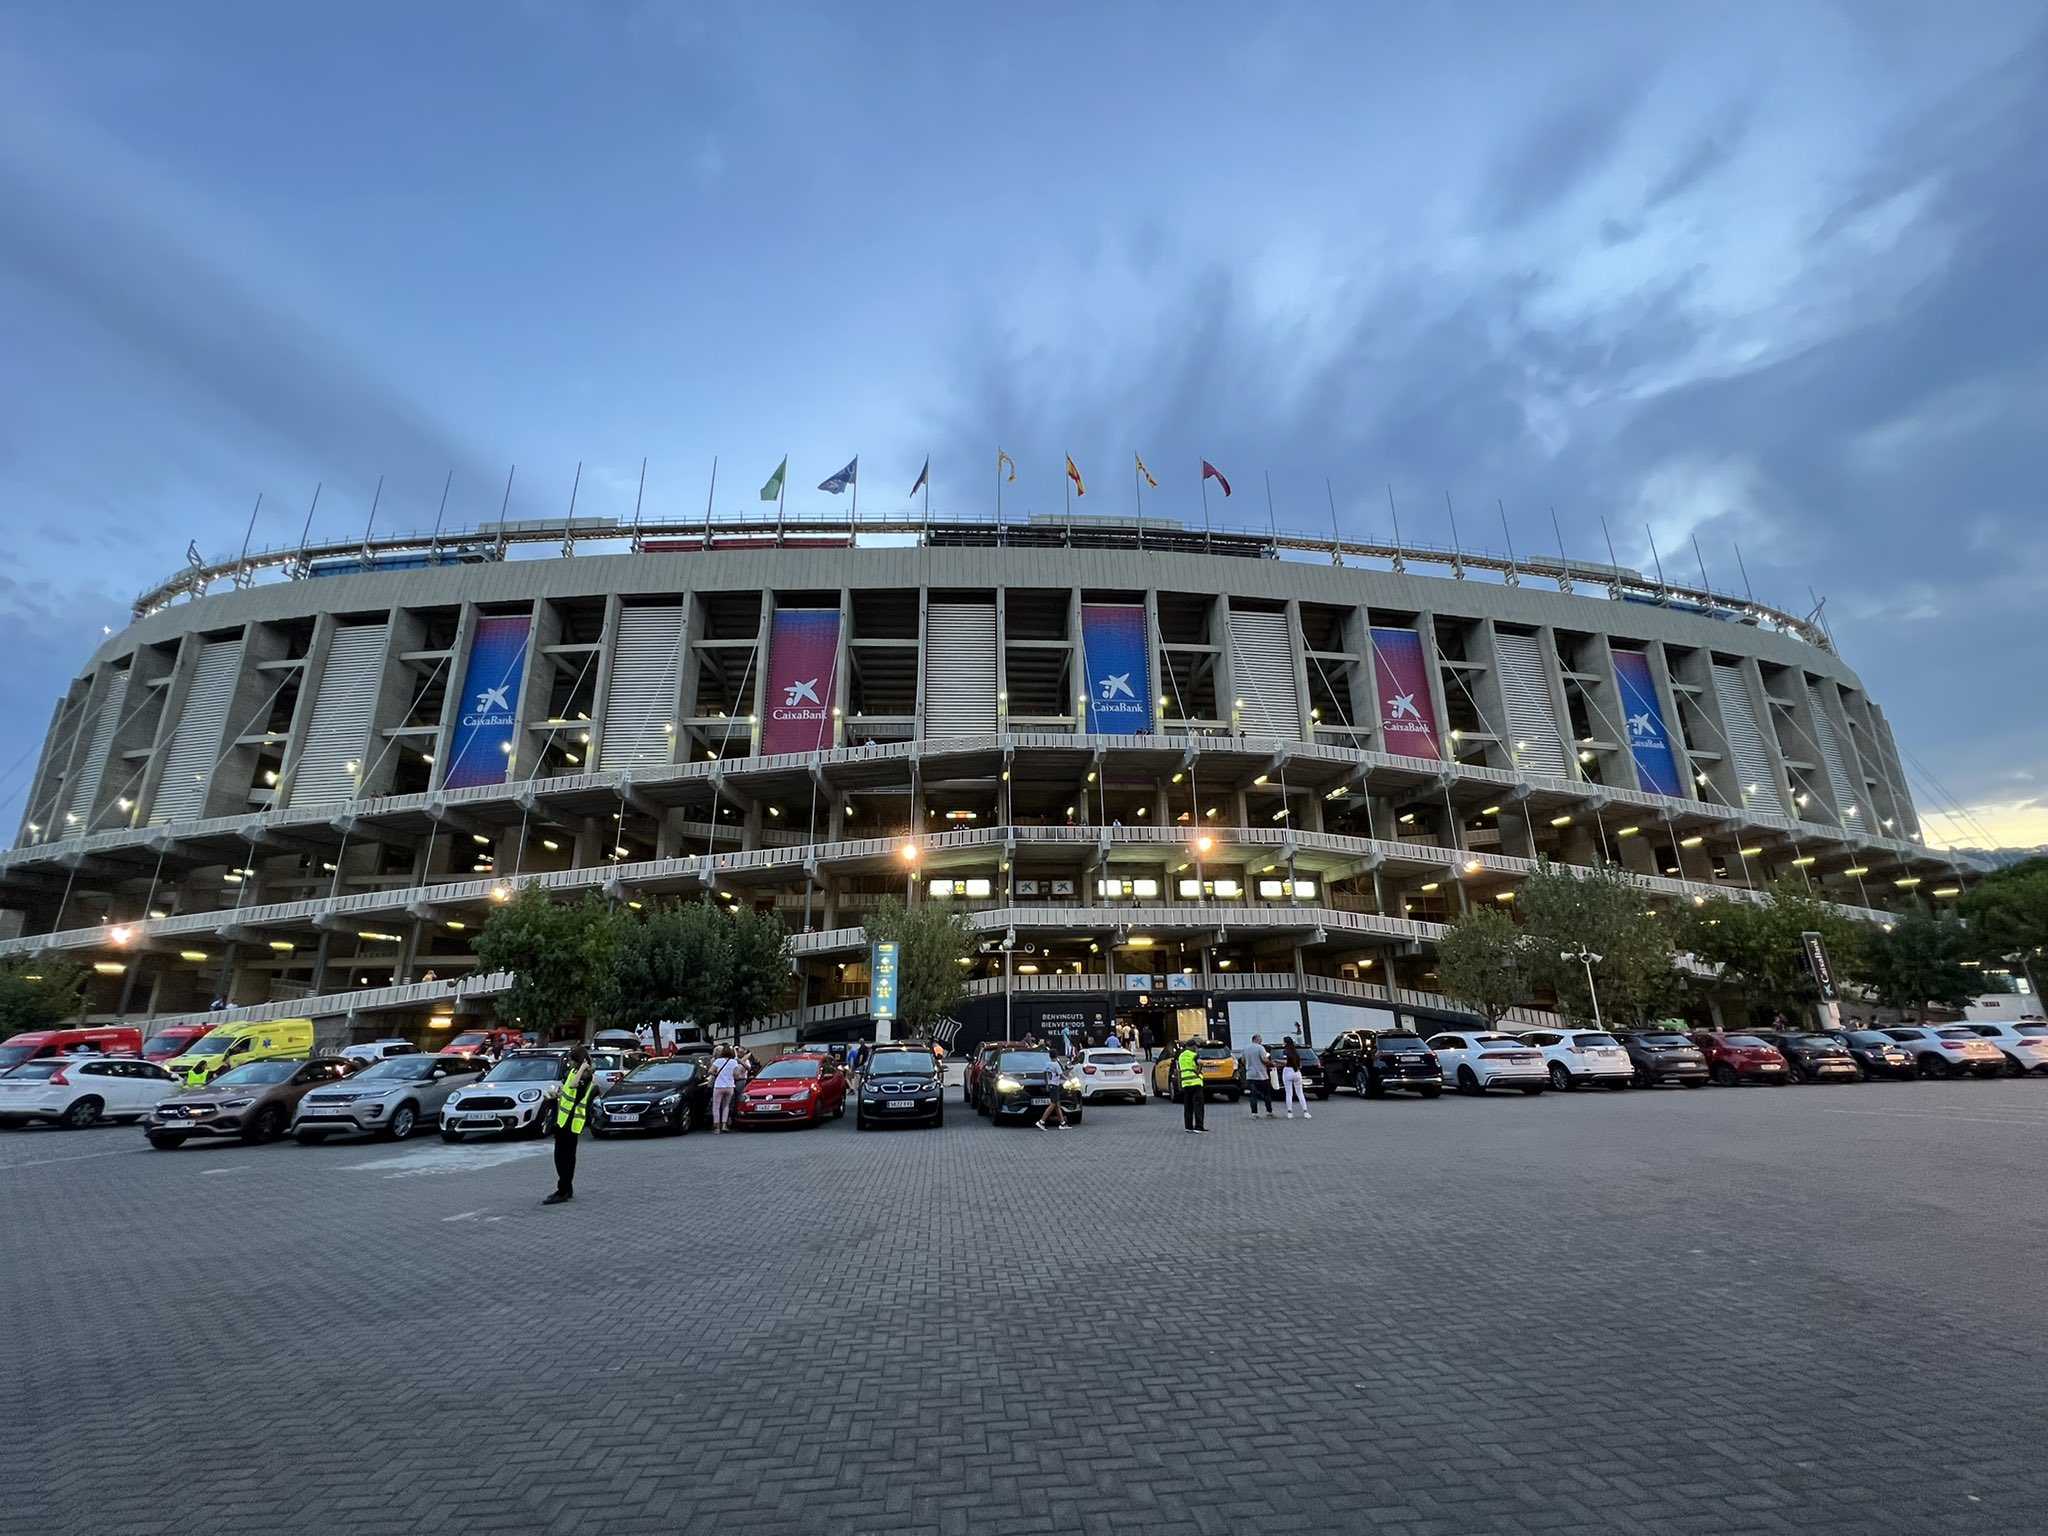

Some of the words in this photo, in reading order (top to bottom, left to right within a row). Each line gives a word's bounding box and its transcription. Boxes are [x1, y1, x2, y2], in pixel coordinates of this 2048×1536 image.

[1091, 701, 1143, 713] CaixaBank
[772, 709, 828, 720] CaixaBank
[462, 715, 515, 727] CaixaBank
[1381, 720, 1431, 733] CaixaBank
